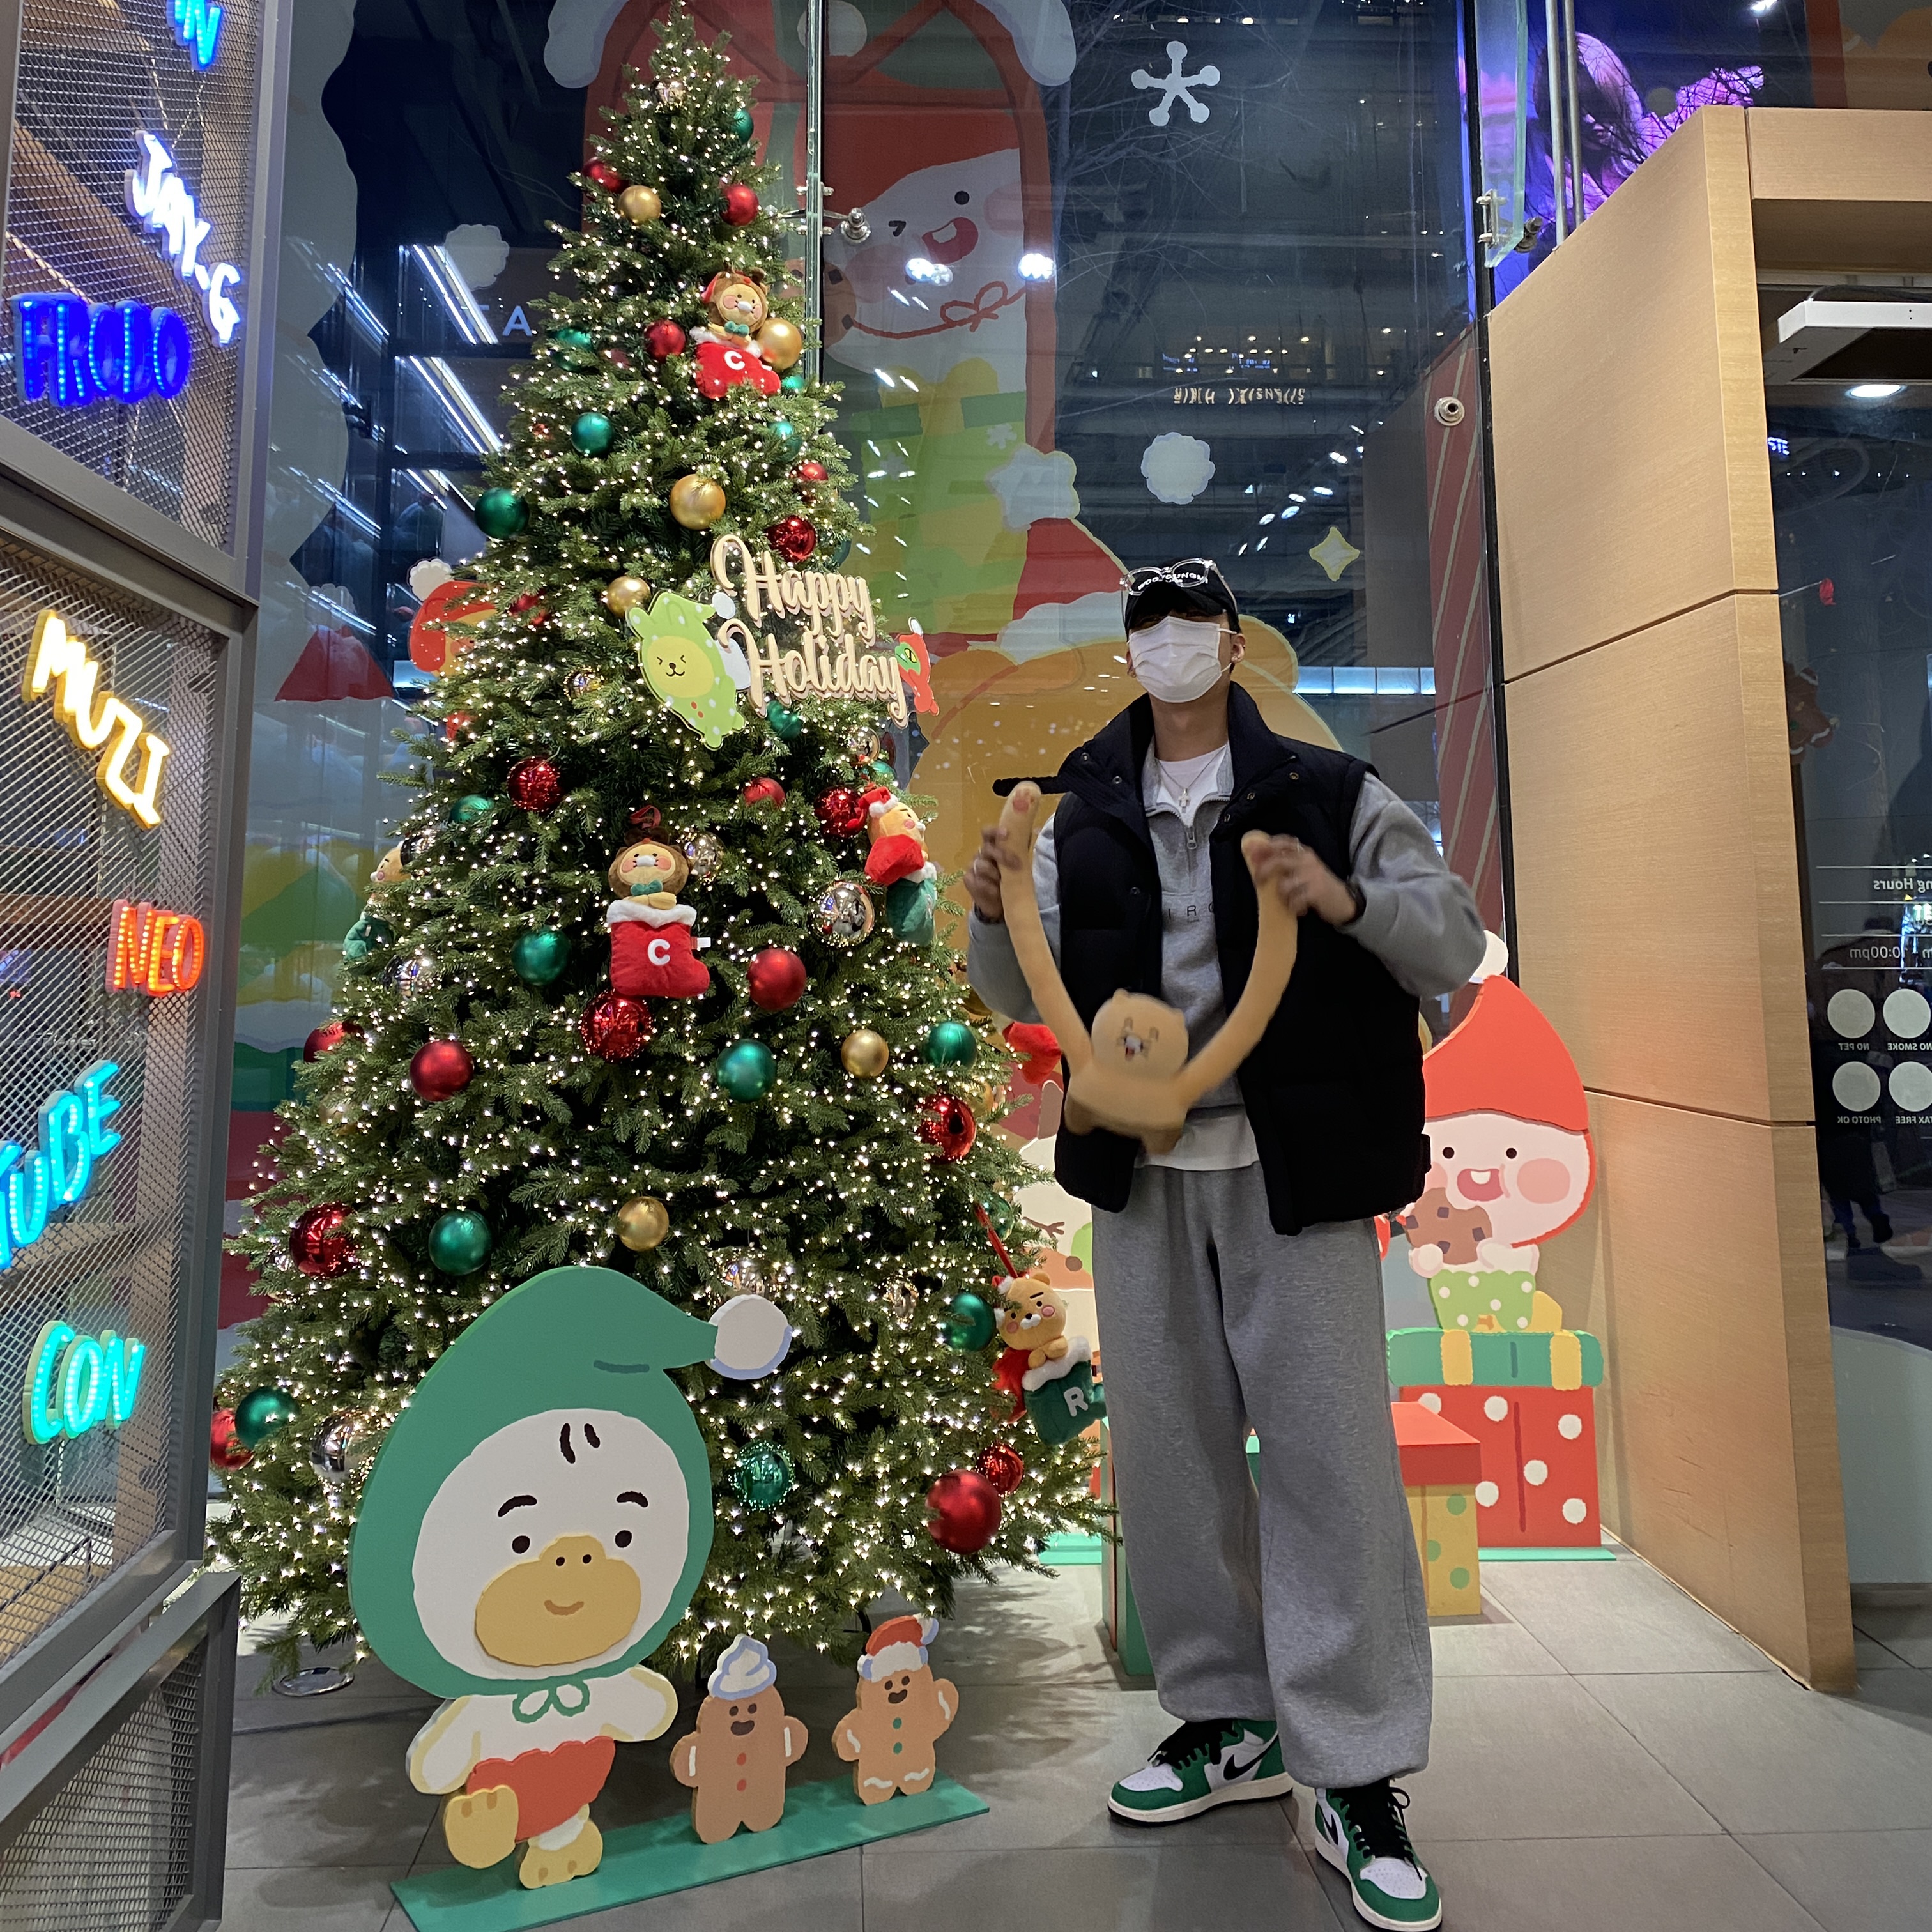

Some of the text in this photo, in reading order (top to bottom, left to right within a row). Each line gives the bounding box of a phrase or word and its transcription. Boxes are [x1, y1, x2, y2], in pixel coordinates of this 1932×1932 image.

[724, 351, 746, 370] C
[710, 534, 876, 643] Happy
[24, 610, 170, 828] MUZI
[717, 618, 908, 725] Holiday
[108, 900, 204, 996] NEO
[648, 939, 671, 966] C
[26, 1321, 144, 1443] CON
[1064, 1386, 1089, 1416] R
